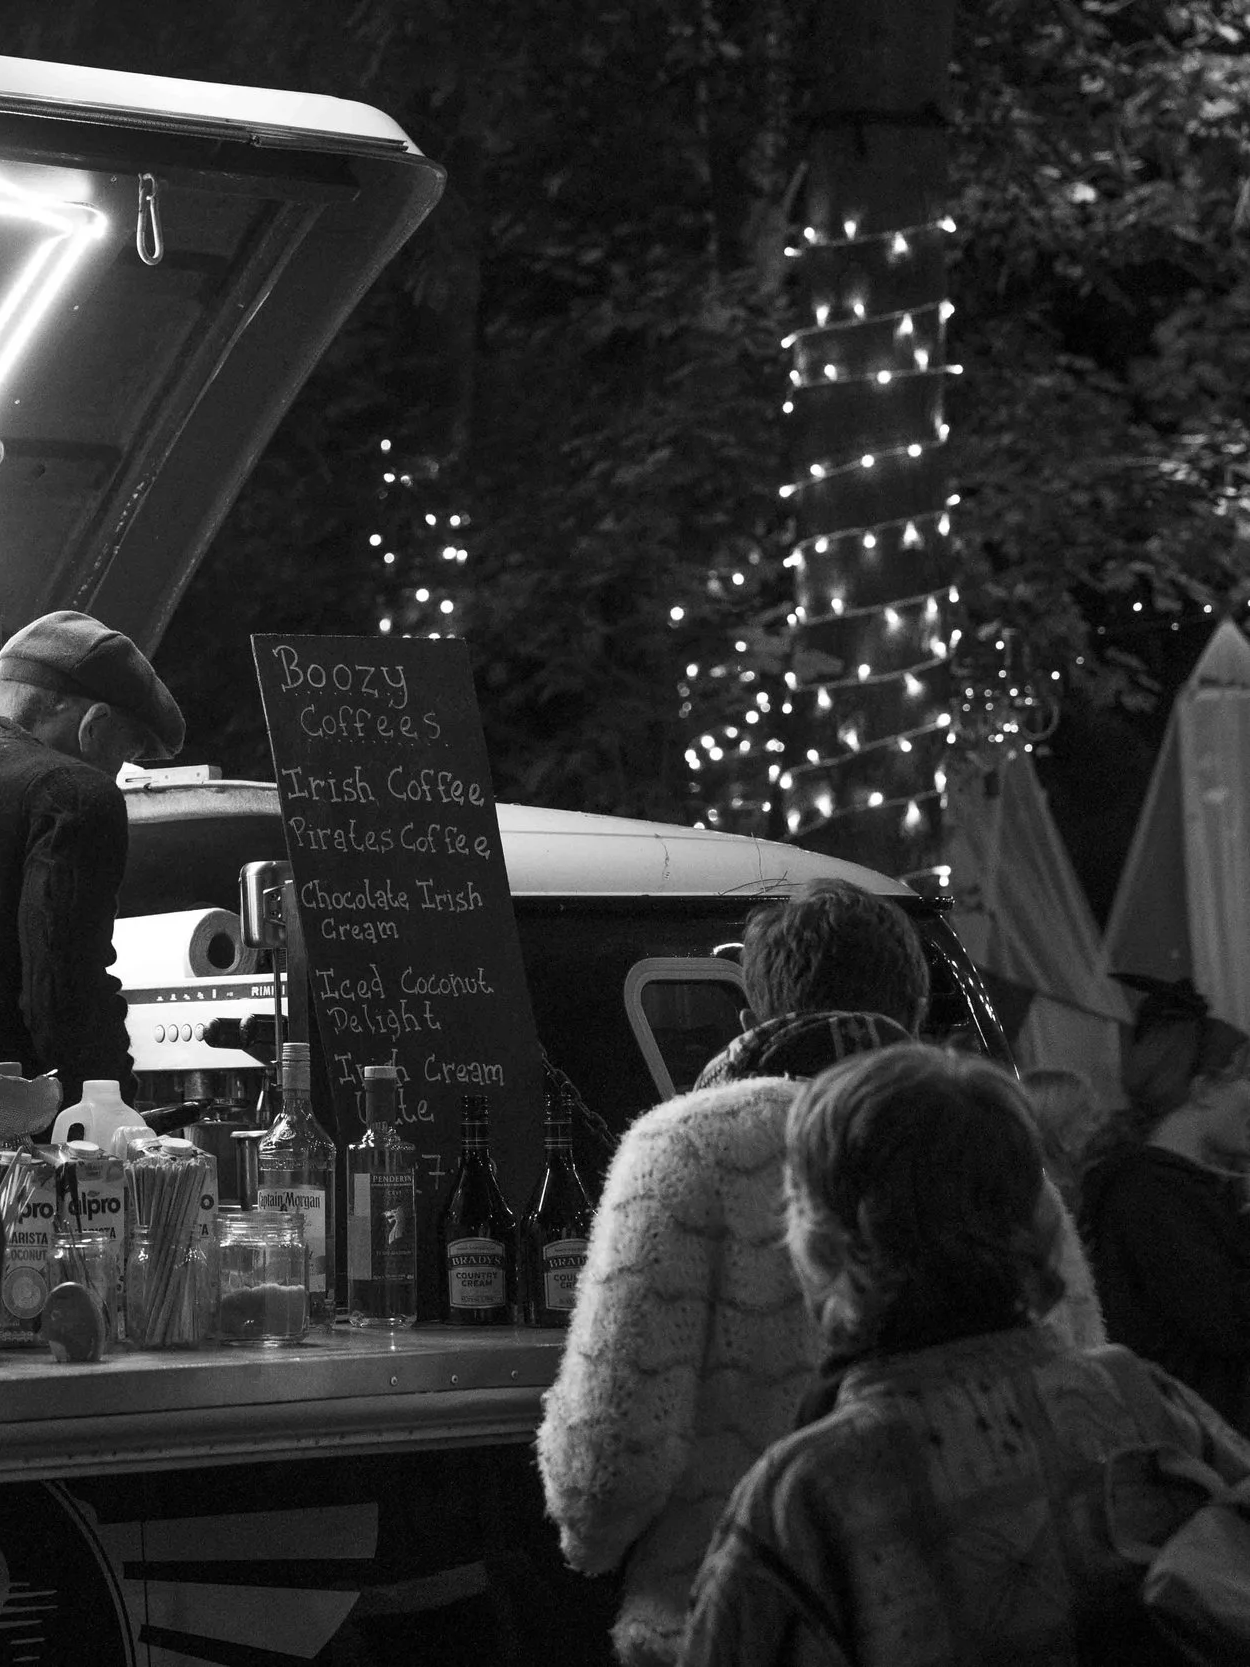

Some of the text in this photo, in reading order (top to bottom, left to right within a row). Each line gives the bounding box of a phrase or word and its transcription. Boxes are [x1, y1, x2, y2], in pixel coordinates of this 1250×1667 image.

[272, 644, 409, 709] Boozy
[300, 703, 442, 740] Coffees
[281, 765, 485, 808] Irish Coffee
[287, 815, 492, 860] Pirates Coffee
[300, 878, 484, 913] Chocolate Irish
[321, 917, 400, 944] Cream
[251, 984, 286, 997] RIMII
[315, 963, 495, 1001] Iced Coconut
[326, 999, 442, 1042] Delight
[423, 1053, 505, 1086] Cream
[284, 1191, 321, 1210] Morgan
